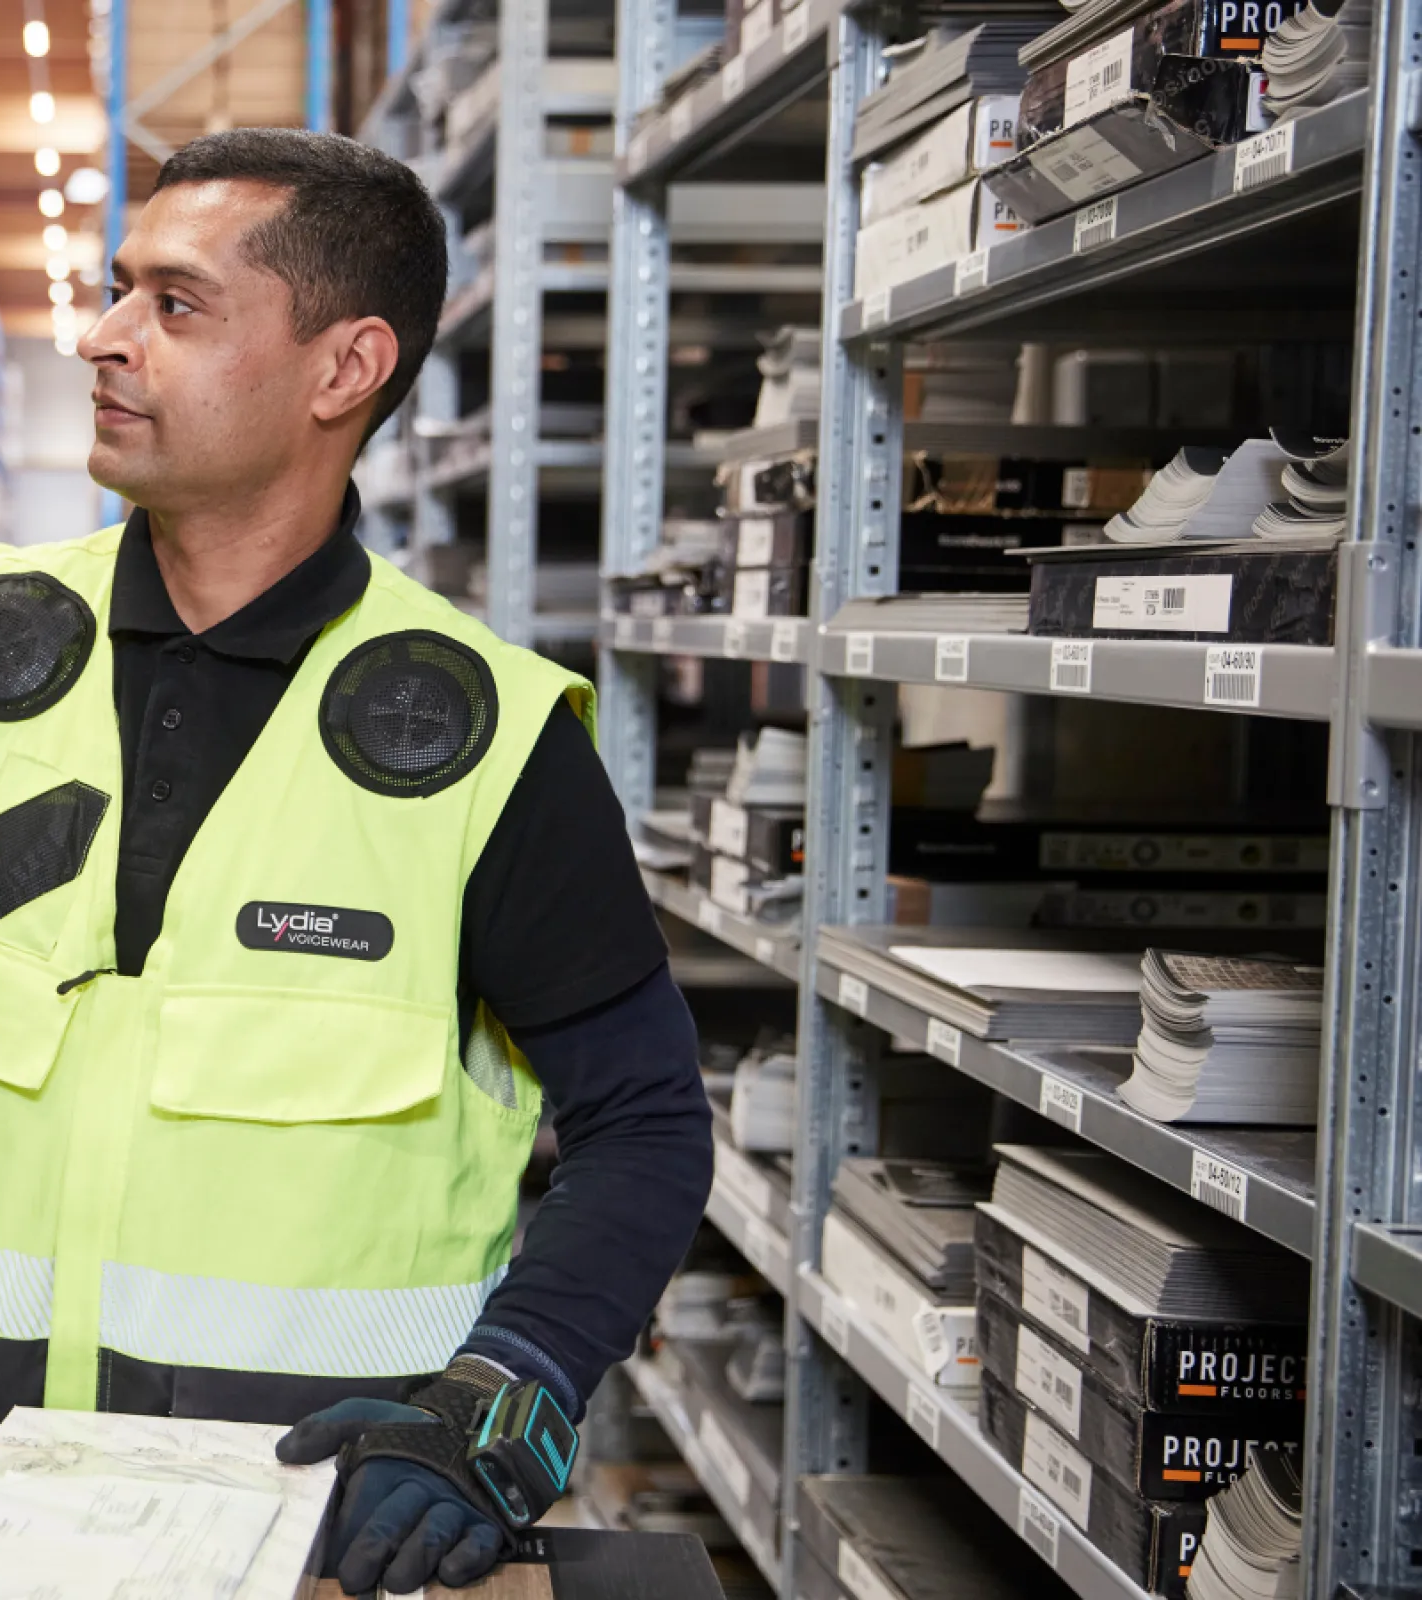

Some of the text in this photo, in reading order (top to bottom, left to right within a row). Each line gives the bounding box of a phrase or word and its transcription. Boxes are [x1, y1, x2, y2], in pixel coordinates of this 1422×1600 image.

[288, 933, 369, 951] VOICEWEAR
[1221, 1385, 1293, 1401] FLOORS
[1164, 1436, 1298, 1469] PROJE
